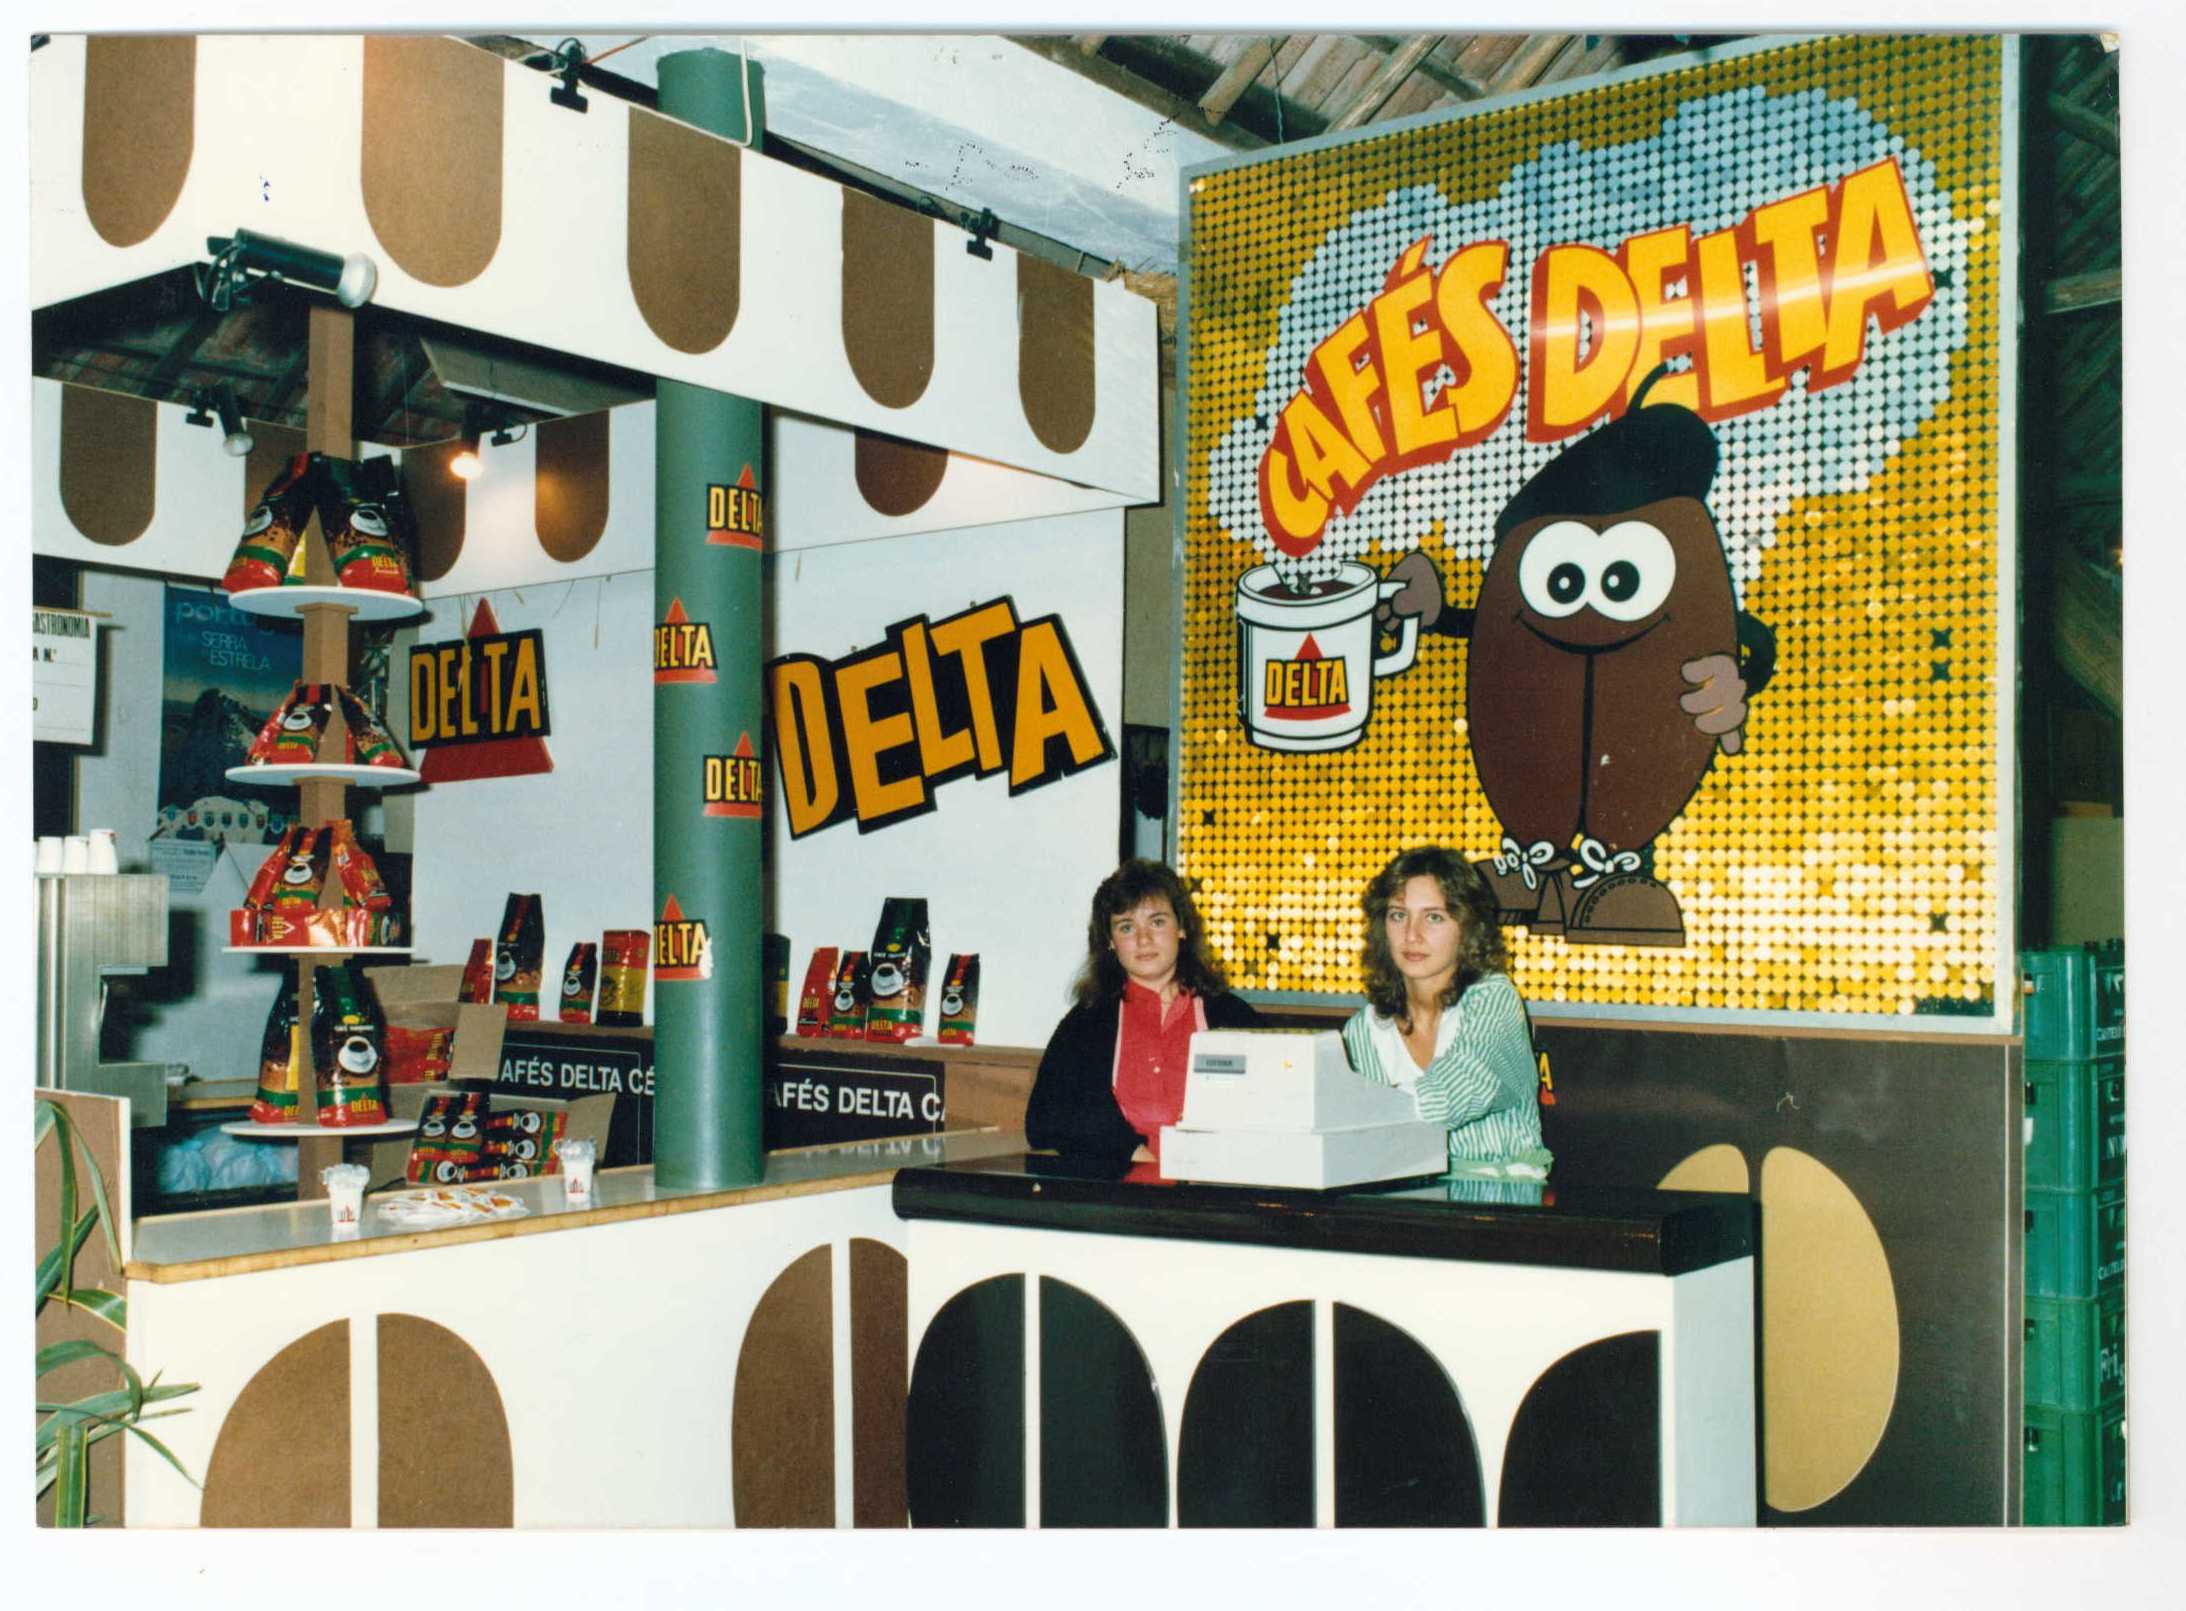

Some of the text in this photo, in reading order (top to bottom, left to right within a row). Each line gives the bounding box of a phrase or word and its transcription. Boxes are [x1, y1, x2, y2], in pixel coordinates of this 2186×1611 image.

[1259, 156, 1935, 556] CAFÉS DELTA
[201, 630, 249, 652] SERRA
[210, 648, 272, 671] ESTRELA
[411, 638, 542, 742] DELTA
[1266, 658, 1347, 706] DELTA
[767, 600, 1106, 835] DELTA
[654, 923, 706, 965] ELTA
[501, 1056, 553, 1087] AFÉS
[560, 1063, 623, 1093] DELTA
[351, 1099, 378, 1113] DELTA
[774, 1078, 946, 1122] FÉS DELTA C
